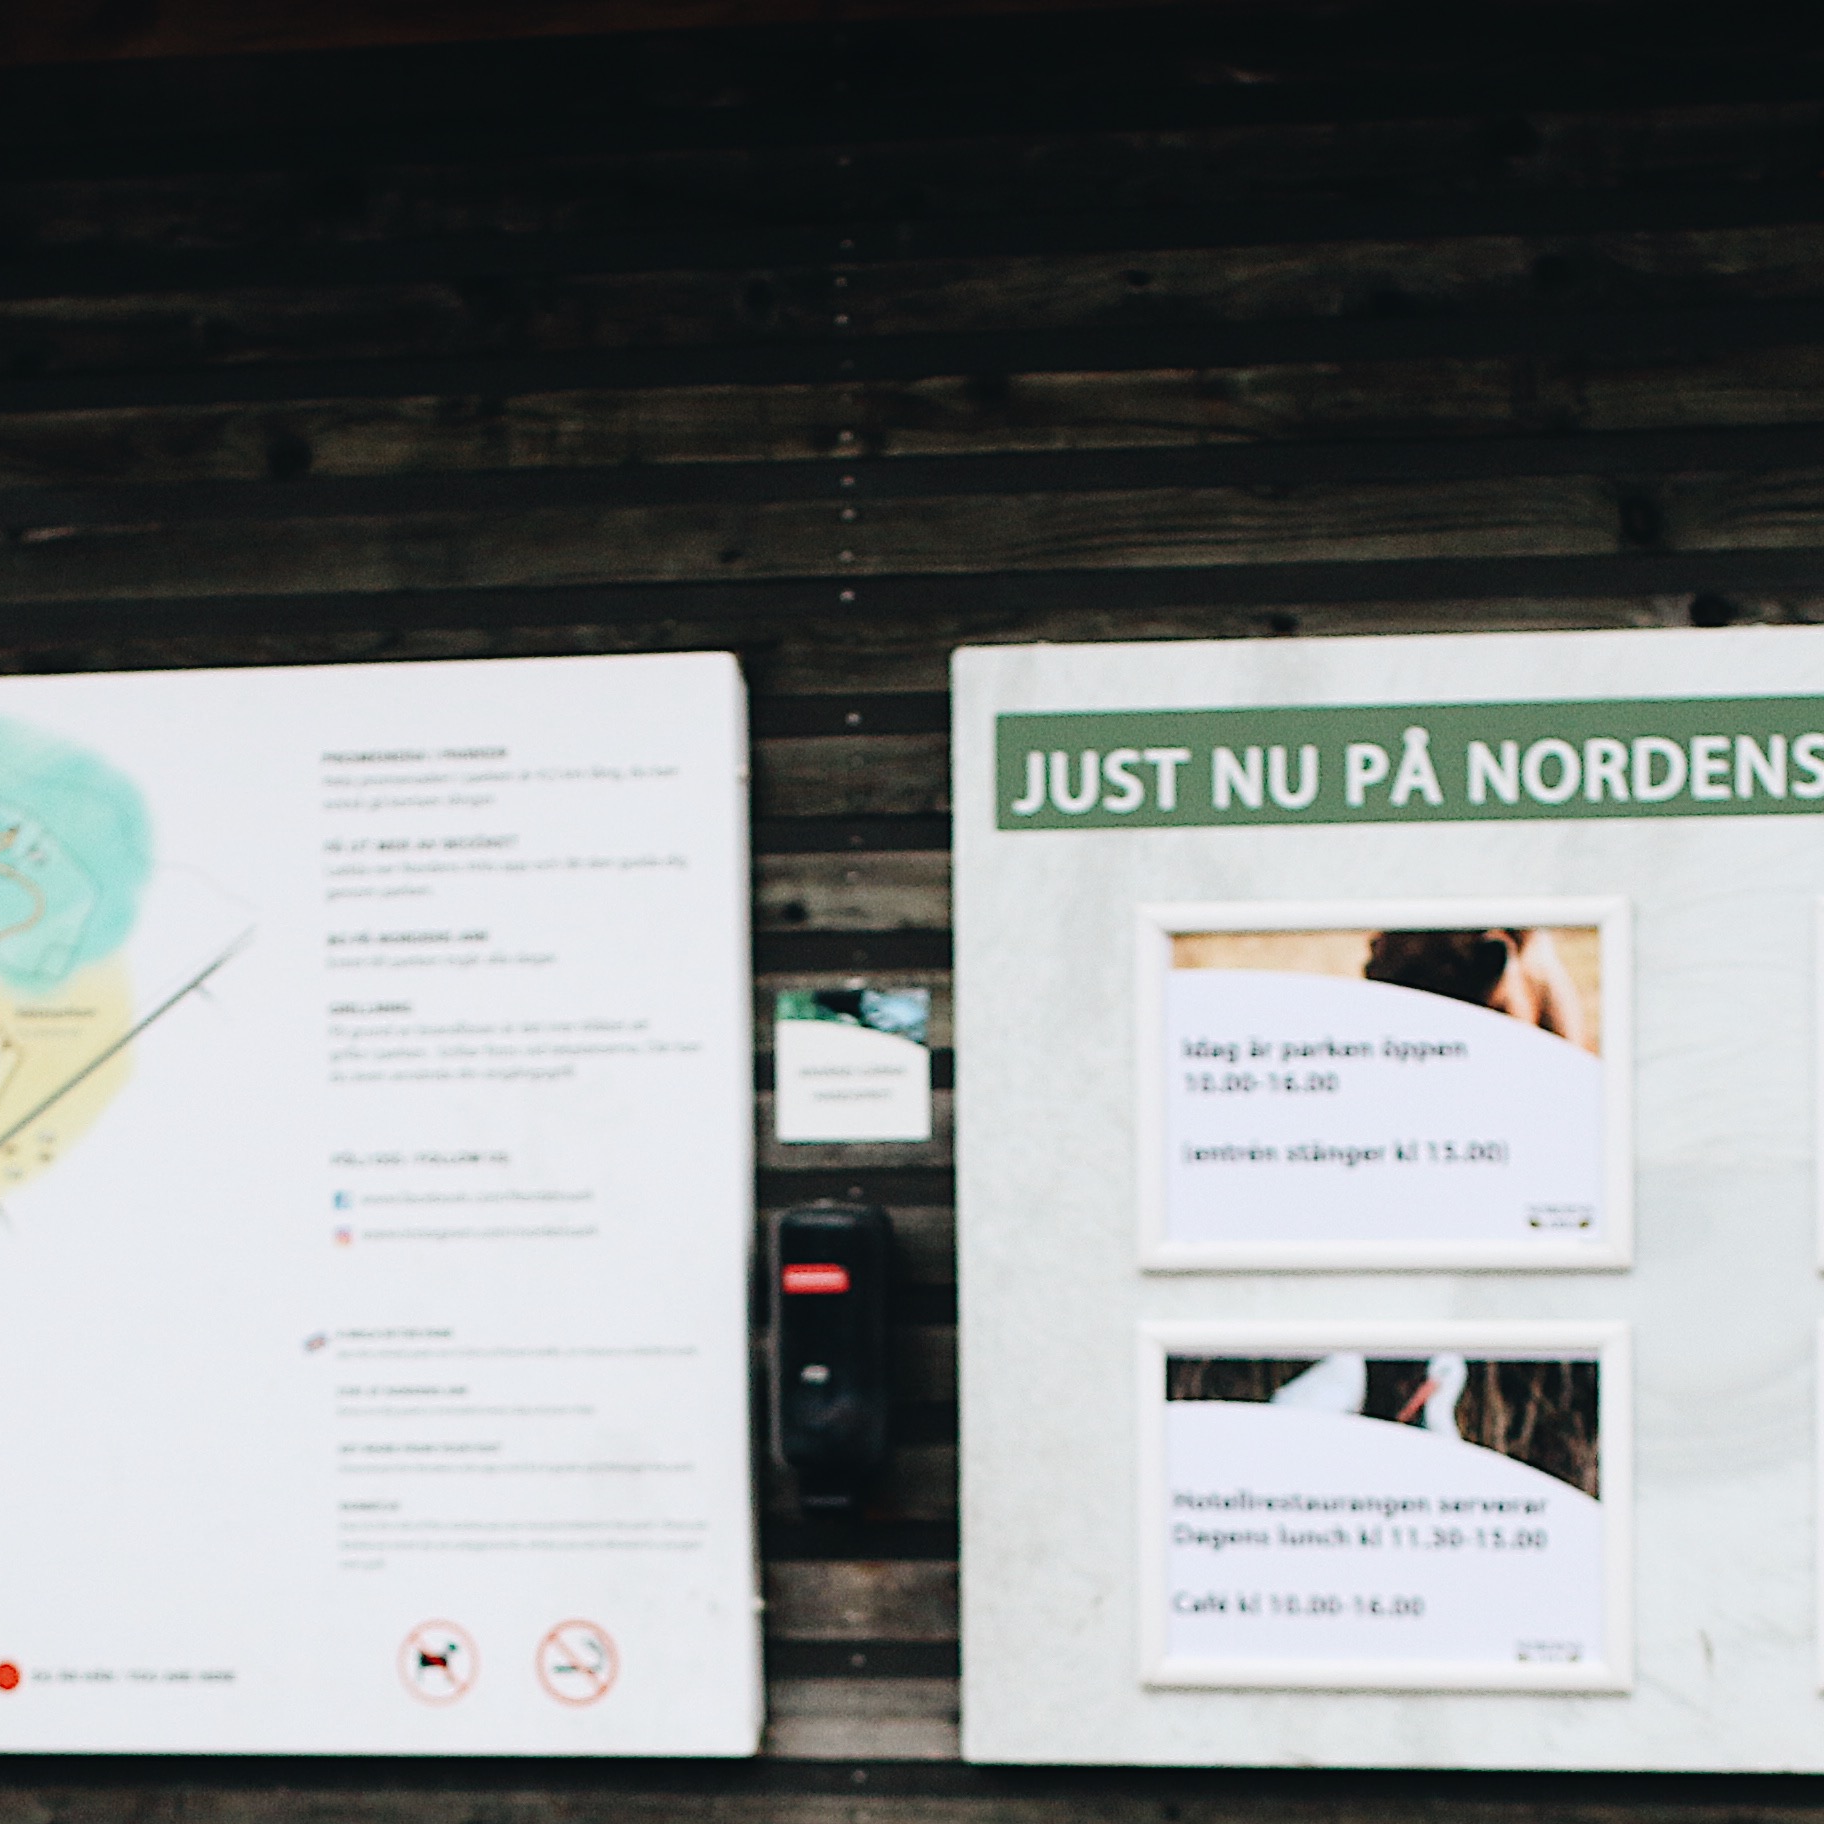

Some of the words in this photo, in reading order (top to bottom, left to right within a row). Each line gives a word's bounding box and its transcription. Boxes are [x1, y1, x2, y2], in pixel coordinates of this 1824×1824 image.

[1012, 748, 1189, 816] JUST
[1210, 745, 1319, 808] NU
[1344, 725, 1445, 807] PÅ
[1181, 1037, 1239, 1063] Idag
[1281, 1035, 1375, 1062] parken
[1277, 1522, 1351, 1547] lunch
